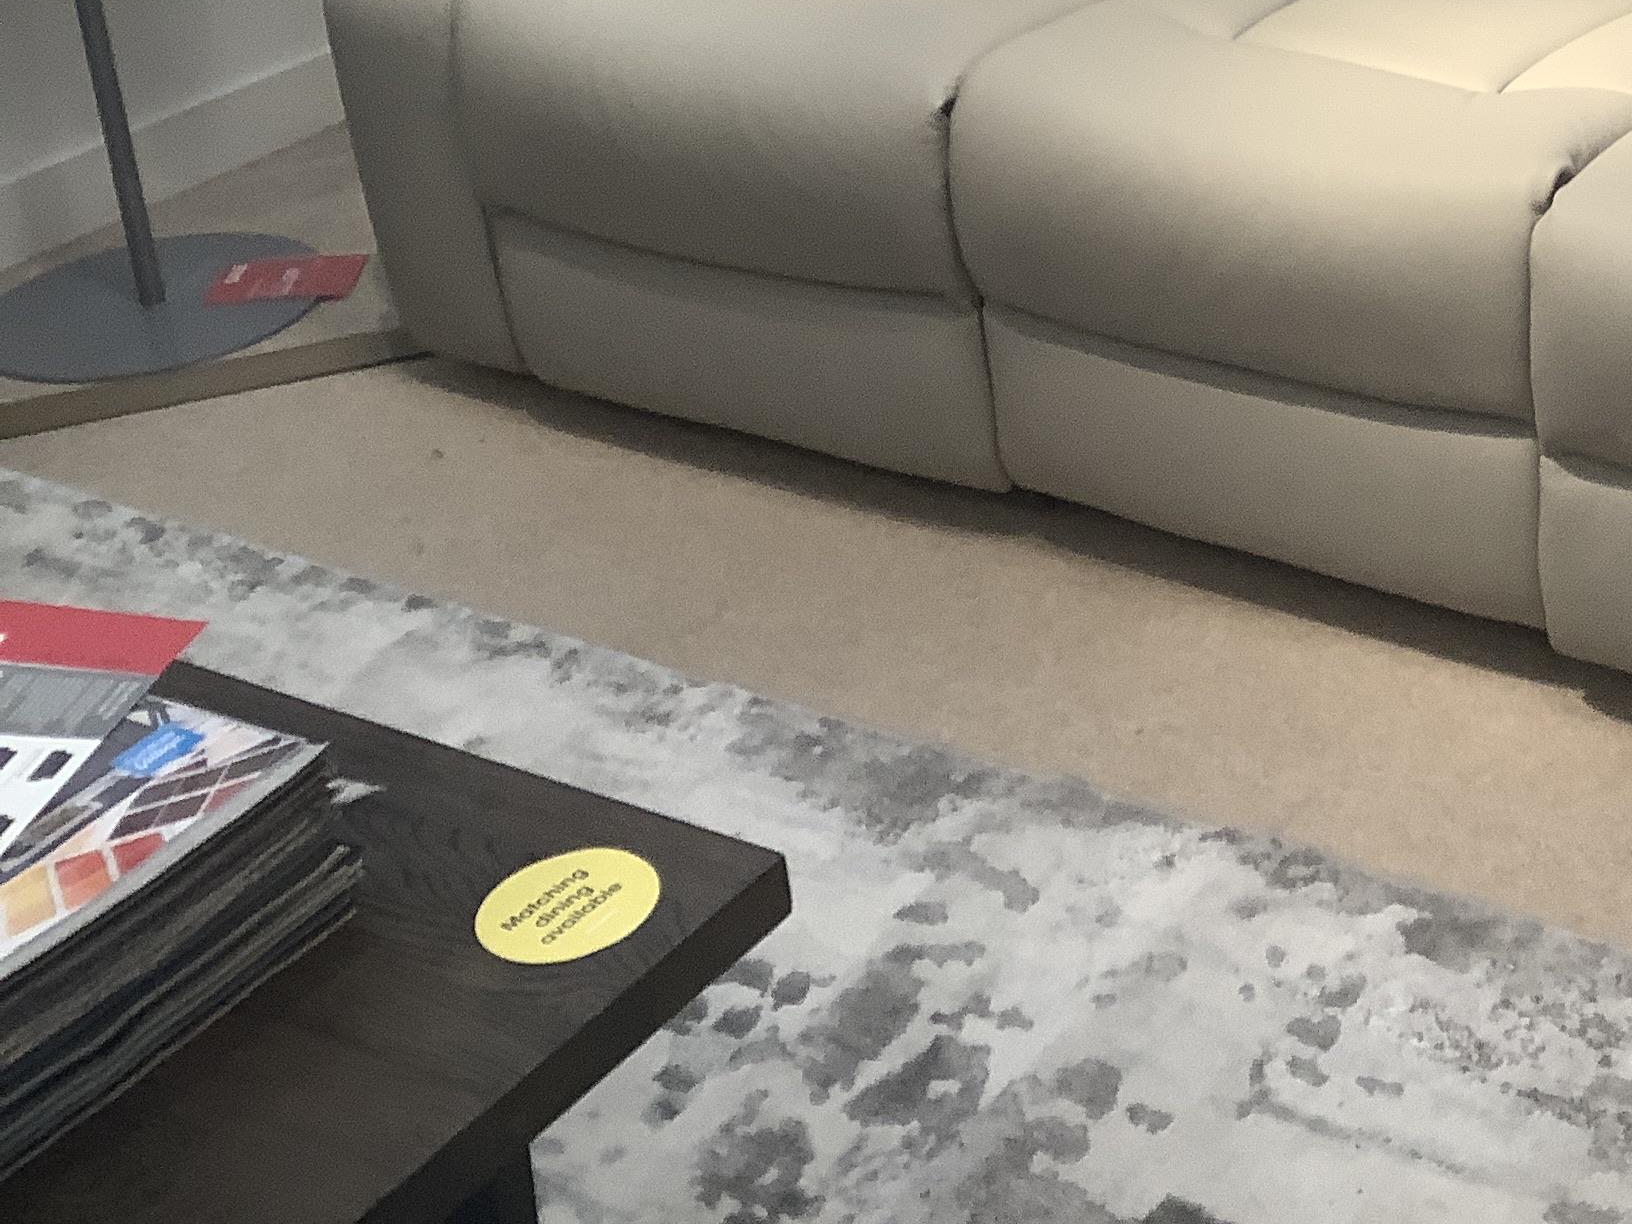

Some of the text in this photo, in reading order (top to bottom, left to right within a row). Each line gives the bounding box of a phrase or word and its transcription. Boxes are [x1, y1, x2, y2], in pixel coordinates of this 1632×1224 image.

[501, 868, 589, 931] Matching
[535, 886, 594, 928] dining
[540, 882, 622, 945] available
